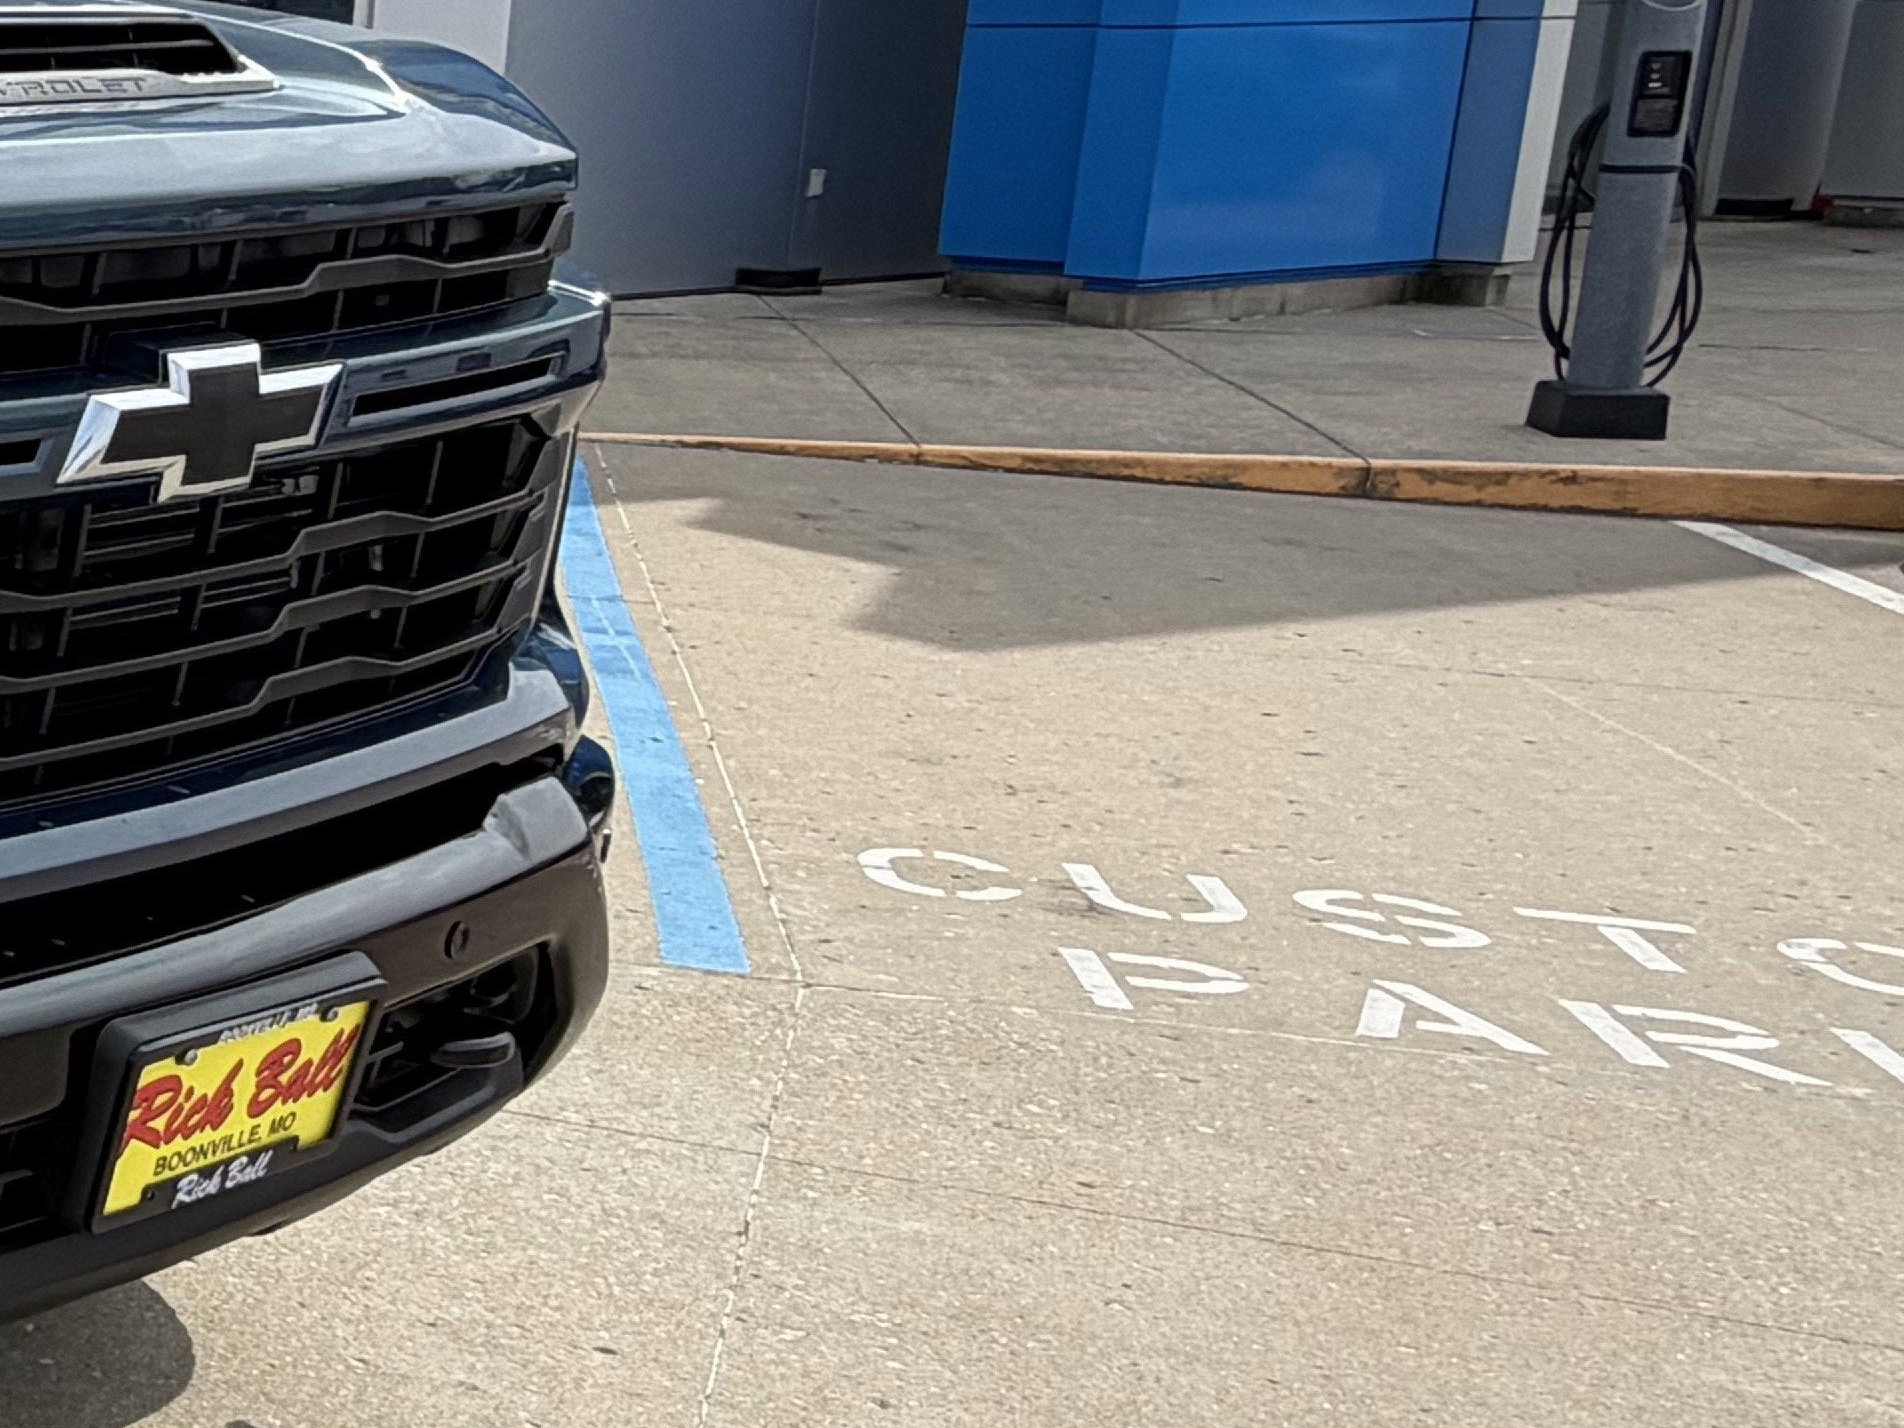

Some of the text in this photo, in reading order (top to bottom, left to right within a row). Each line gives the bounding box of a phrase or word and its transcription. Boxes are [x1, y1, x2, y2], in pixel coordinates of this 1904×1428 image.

[119, 1024, 361, 1150] Rick Ball
[170, 1149, 274, 1210] Rick Ball
